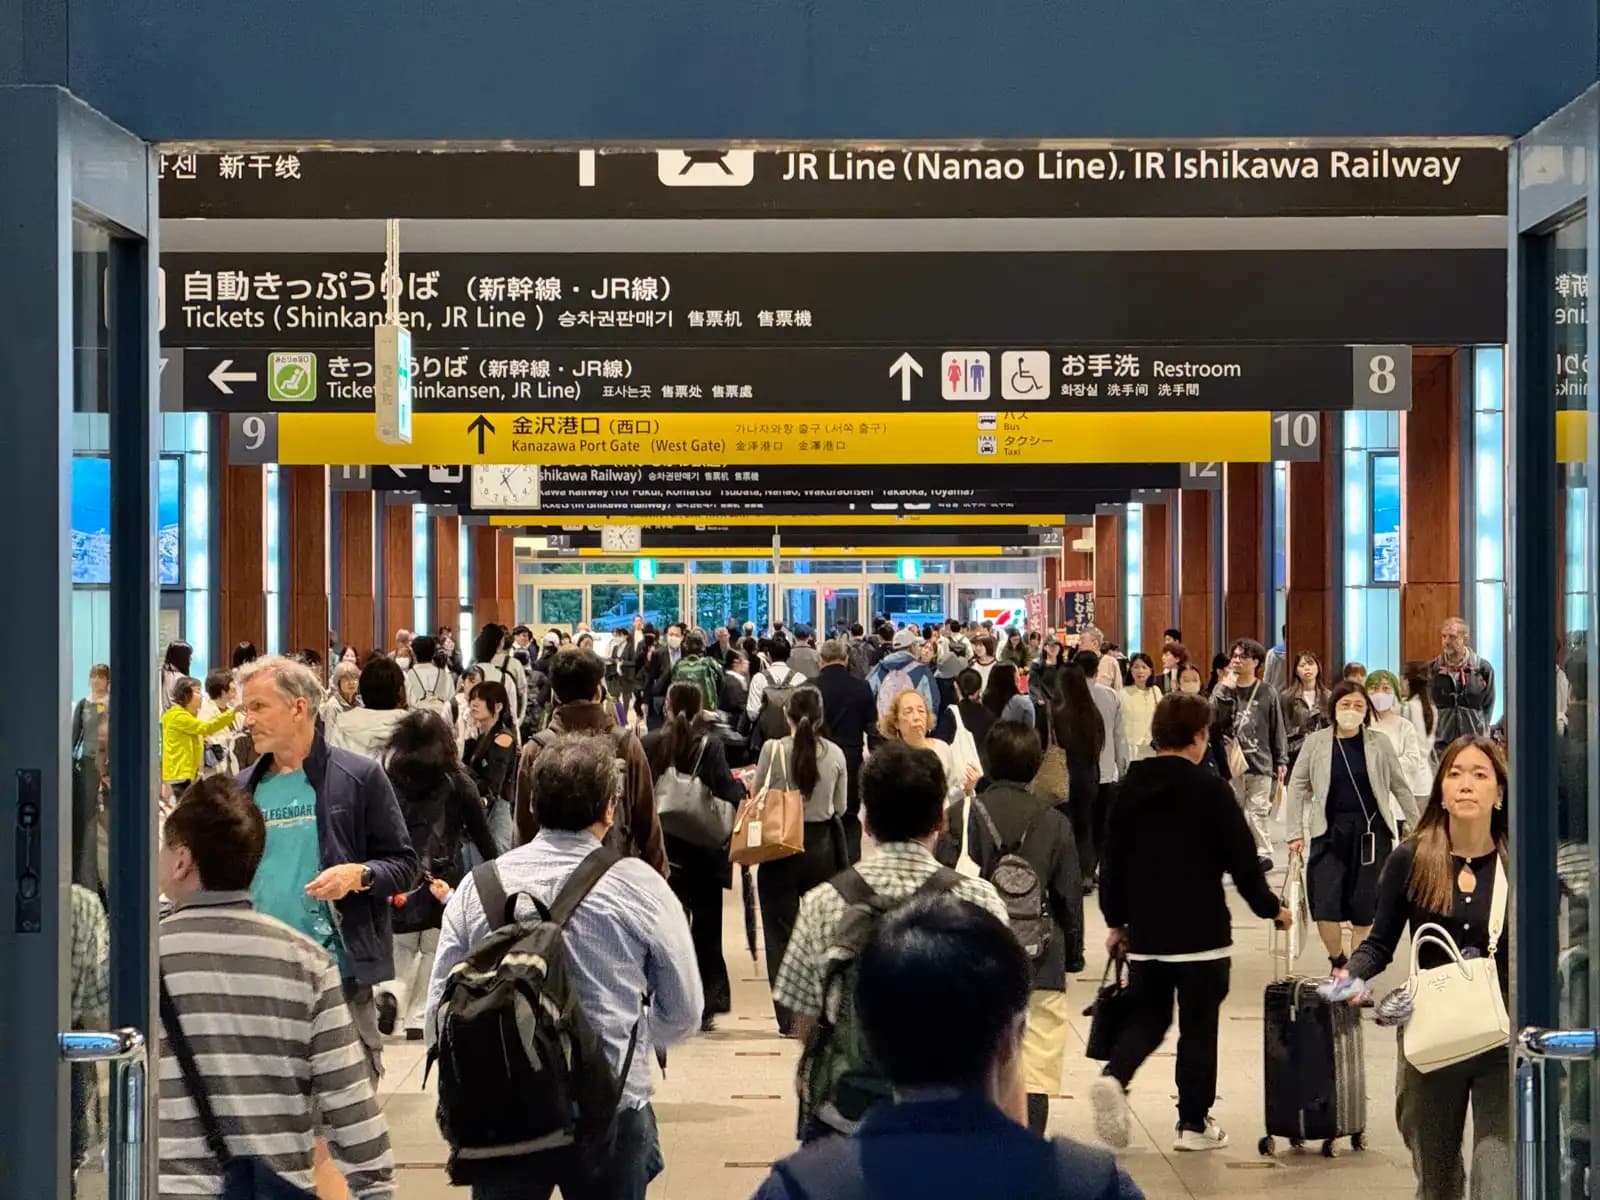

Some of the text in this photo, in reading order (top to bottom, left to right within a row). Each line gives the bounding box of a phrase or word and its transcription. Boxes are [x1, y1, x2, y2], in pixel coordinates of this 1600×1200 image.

[217, 153, 300, 179] 新干线
[782, 153, 1461, 184] JR Line (Nanao Line), IR Ishikawa Railway
[182, 304, 265, 328] Tickets
[442, 306, 468, 328] JR
[478, 305, 526, 328] Line
[558, 309, 673, 328] 승차권판매기
[687, 310, 813, 328] 售票机 售票機
[1062, 354, 1241, 378] お手洗 Restroom
[1368, 355, 1396, 394] 8
[511, 381, 532, 399] JR
[538, 380, 581, 401] Line)
[602, 384, 652, 399] 표사는곳
[661, 384, 753, 399] 售票处 售票處
[1060, 383, 1200, 397] 화장실 洗手间 洗手間
[242, 416, 267, 450] 9
[512, 415, 600, 435] 金沢港口
[736, 423, 794, 434] 가나자와항
[1003, 422, 1021, 432] Bus
[1273, 413, 1318, 447] 10
[512, 438, 726, 455] Kanazawa Port Gate (West Gate)
[1004, 436, 1054, 447] タクシー
[1003, 448, 1022, 457] Taxi
[539, 468, 642, 485] shikawa Railway)
[550, 535, 565, 546] 21
[265, 804, 313, 819] LEGENDAR
